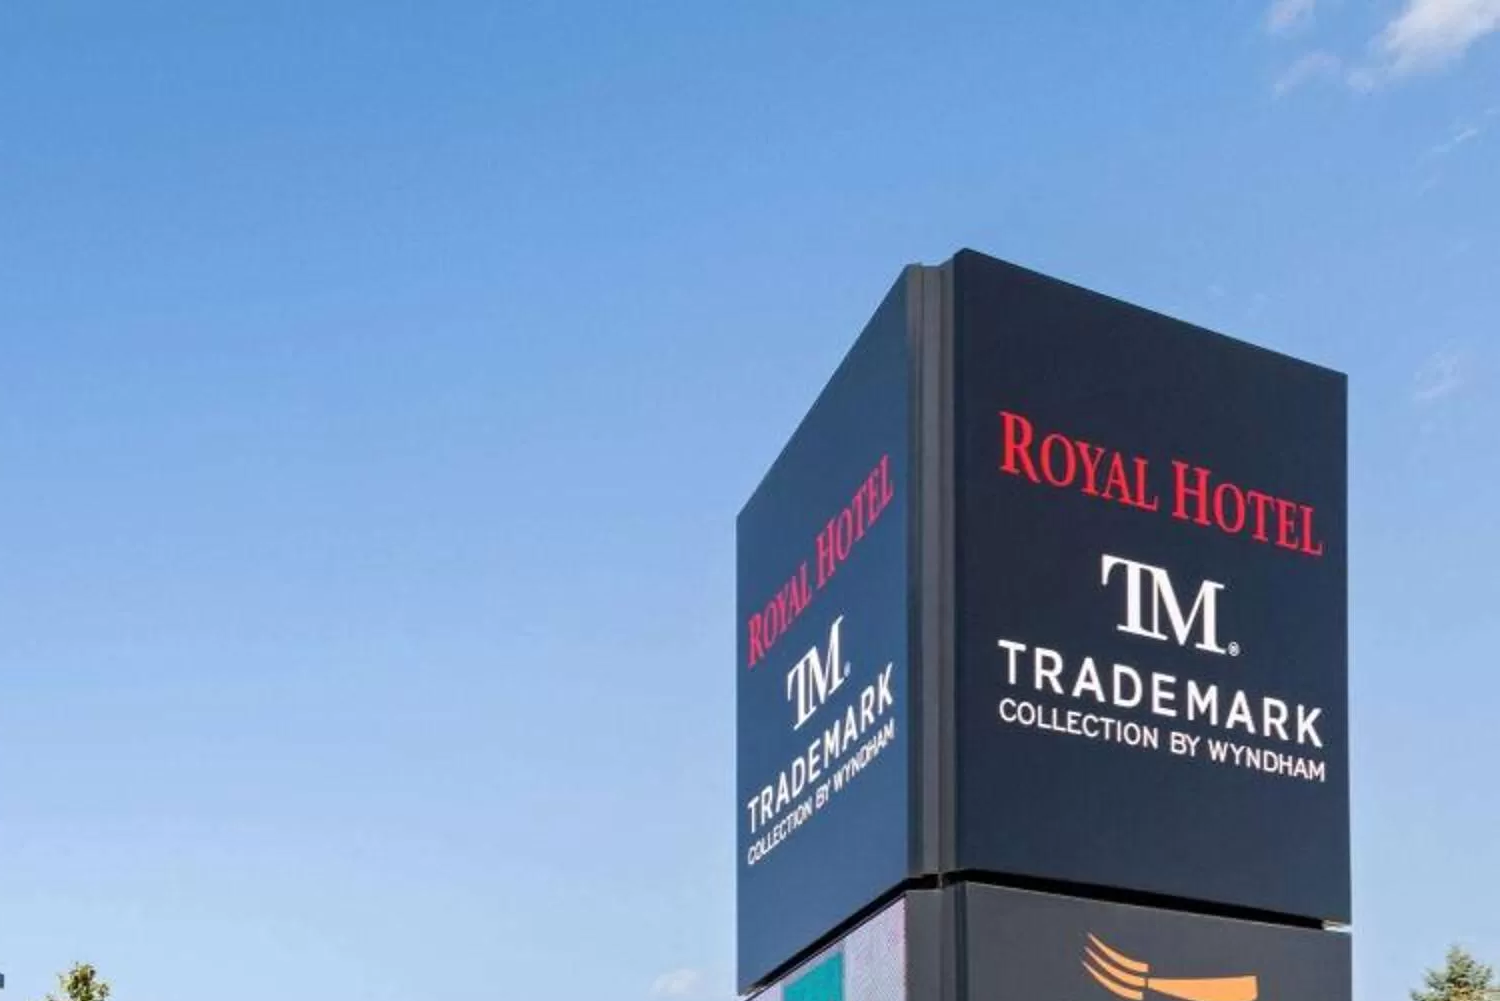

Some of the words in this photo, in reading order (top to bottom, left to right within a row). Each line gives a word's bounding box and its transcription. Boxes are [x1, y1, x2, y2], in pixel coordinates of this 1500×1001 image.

[1000, 411, 1158, 512] ROYAL
[1172, 459, 1322, 556] HOTEL
[747, 561, 812, 668] ROYAL
[815, 454, 894, 590] HOTEL
[747, 662, 894, 833] TRADEMARK
[998, 639, 1322, 748] TRADEMARK
[999, 698, 1158, 750] COLLECTION
[1171, 732, 1200, 757] BY
[1208, 740, 1326, 783] WYNDHAM
[748, 796, 813, 865] COLLECTION
[815, 779, 831, 809] BY
[833, 717, 895, 791] WYNDHAM
